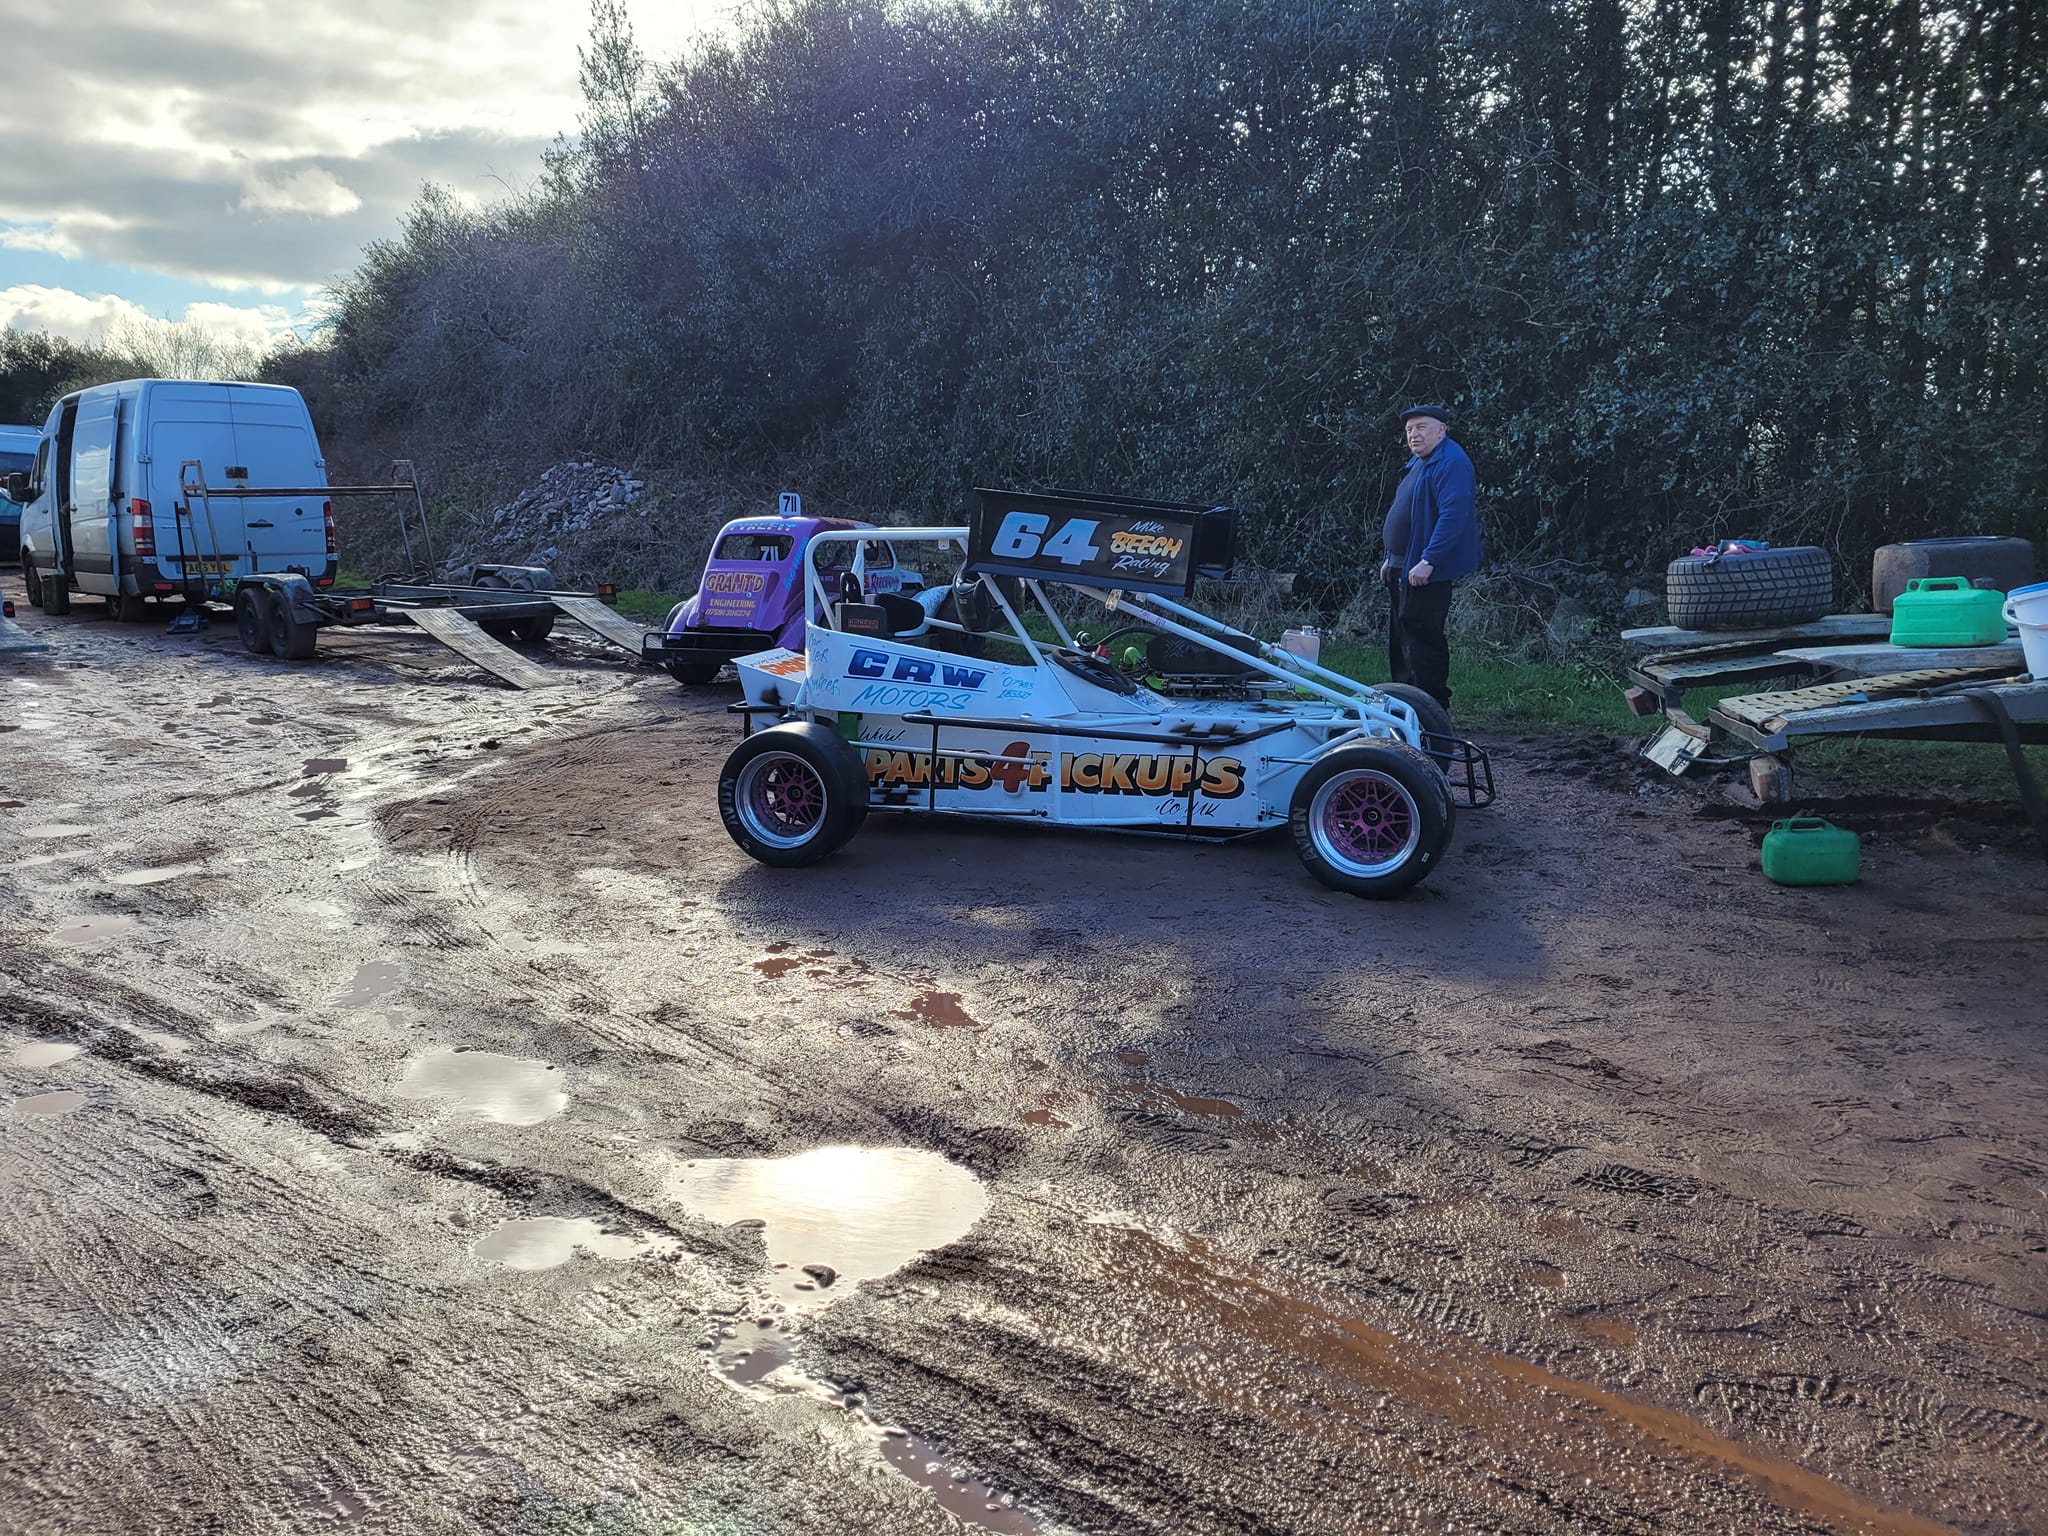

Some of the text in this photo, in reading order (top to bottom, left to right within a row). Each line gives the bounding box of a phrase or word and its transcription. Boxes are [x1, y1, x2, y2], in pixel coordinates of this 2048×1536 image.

[783, 495, 797, 513] 711
[990, 511, 1100, 566] 64
[1110, 531, 1183, 560] BEECH
[1111, 554, 1171, 579] Racing
[710, 598, 757, 608] ENGINEERING
[851, 683, 973, 711] MOTORS
